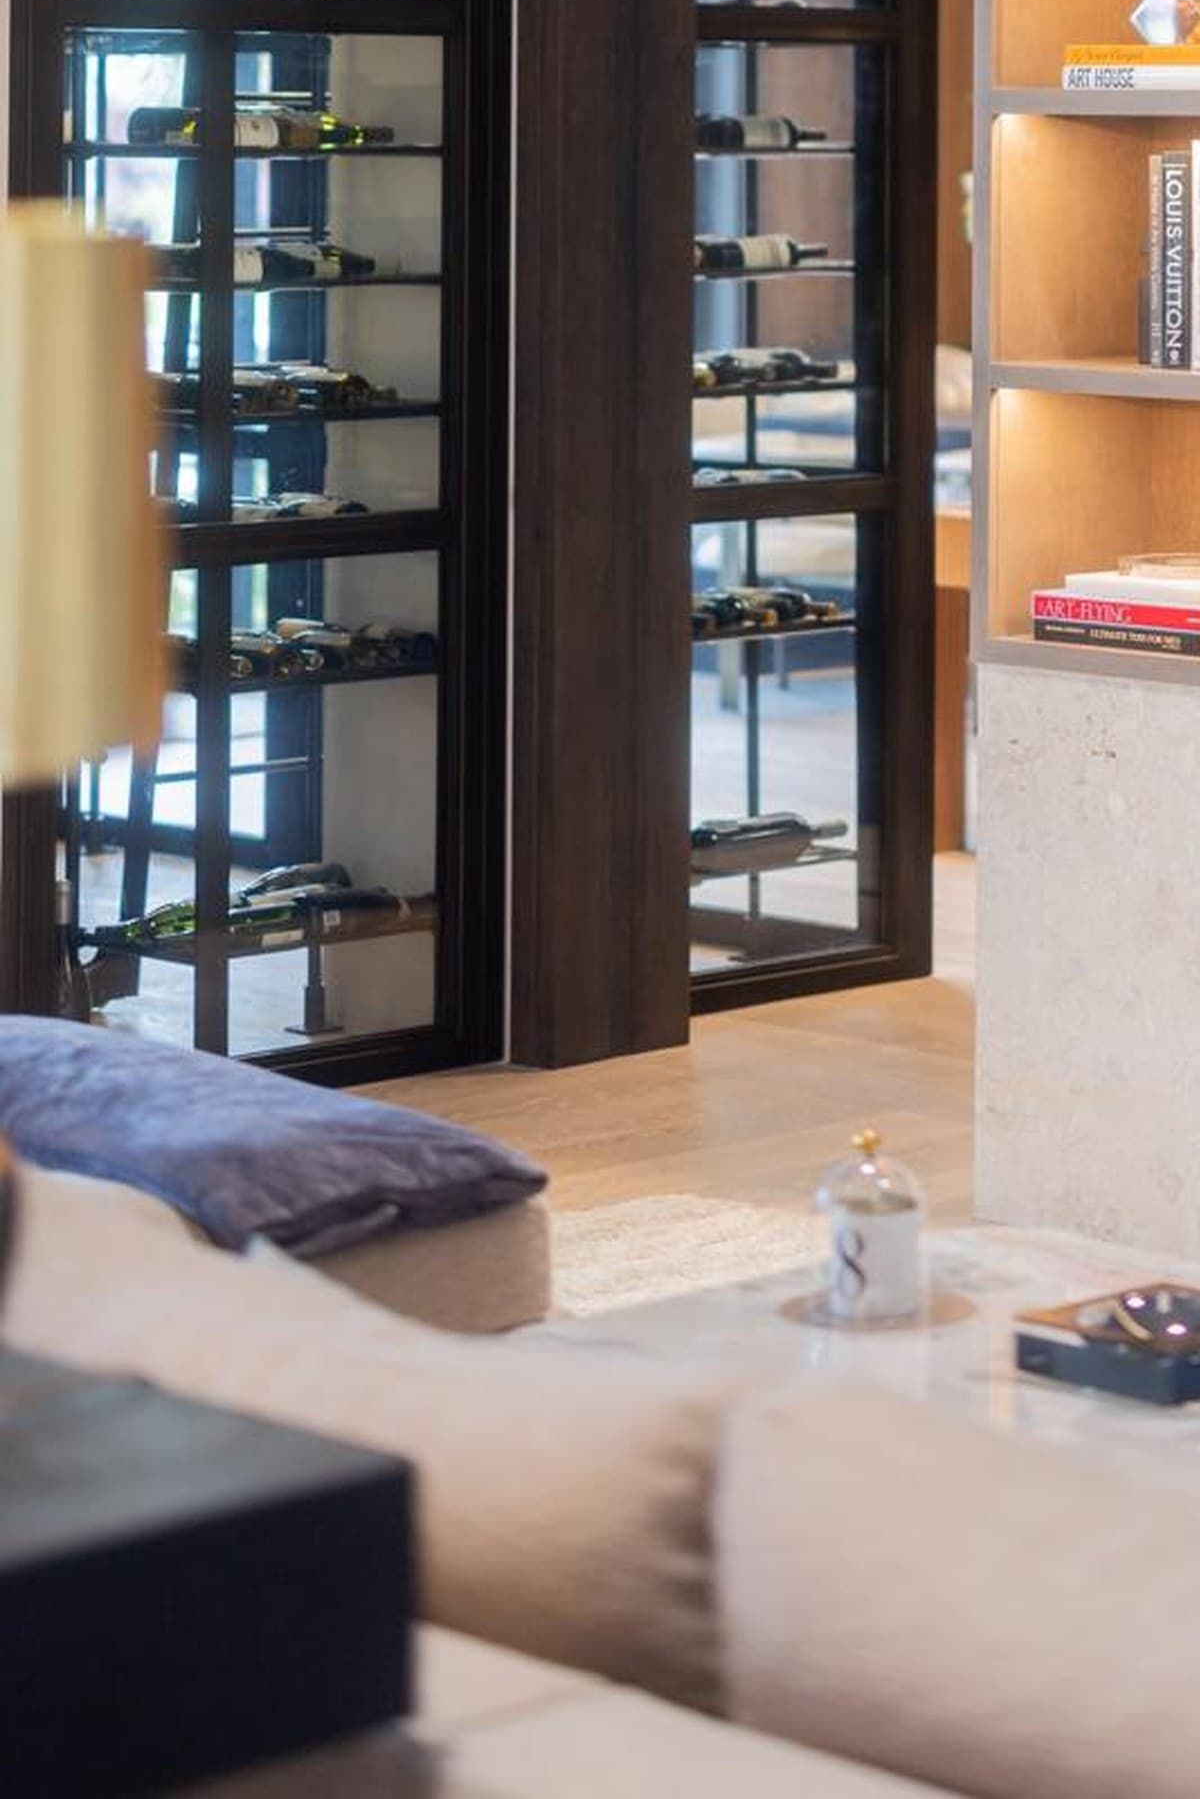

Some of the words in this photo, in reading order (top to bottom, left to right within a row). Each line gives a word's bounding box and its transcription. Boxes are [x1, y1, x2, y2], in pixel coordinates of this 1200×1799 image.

[1067, 68, 1091, 89] ART
[1095, 68, 1135, 89] HOUSE
[1165, 169, 1183, 238] LOUIS
[1165, 244, 1183, 349] VUITTON
[1042, 598, 1076, 618] ART
